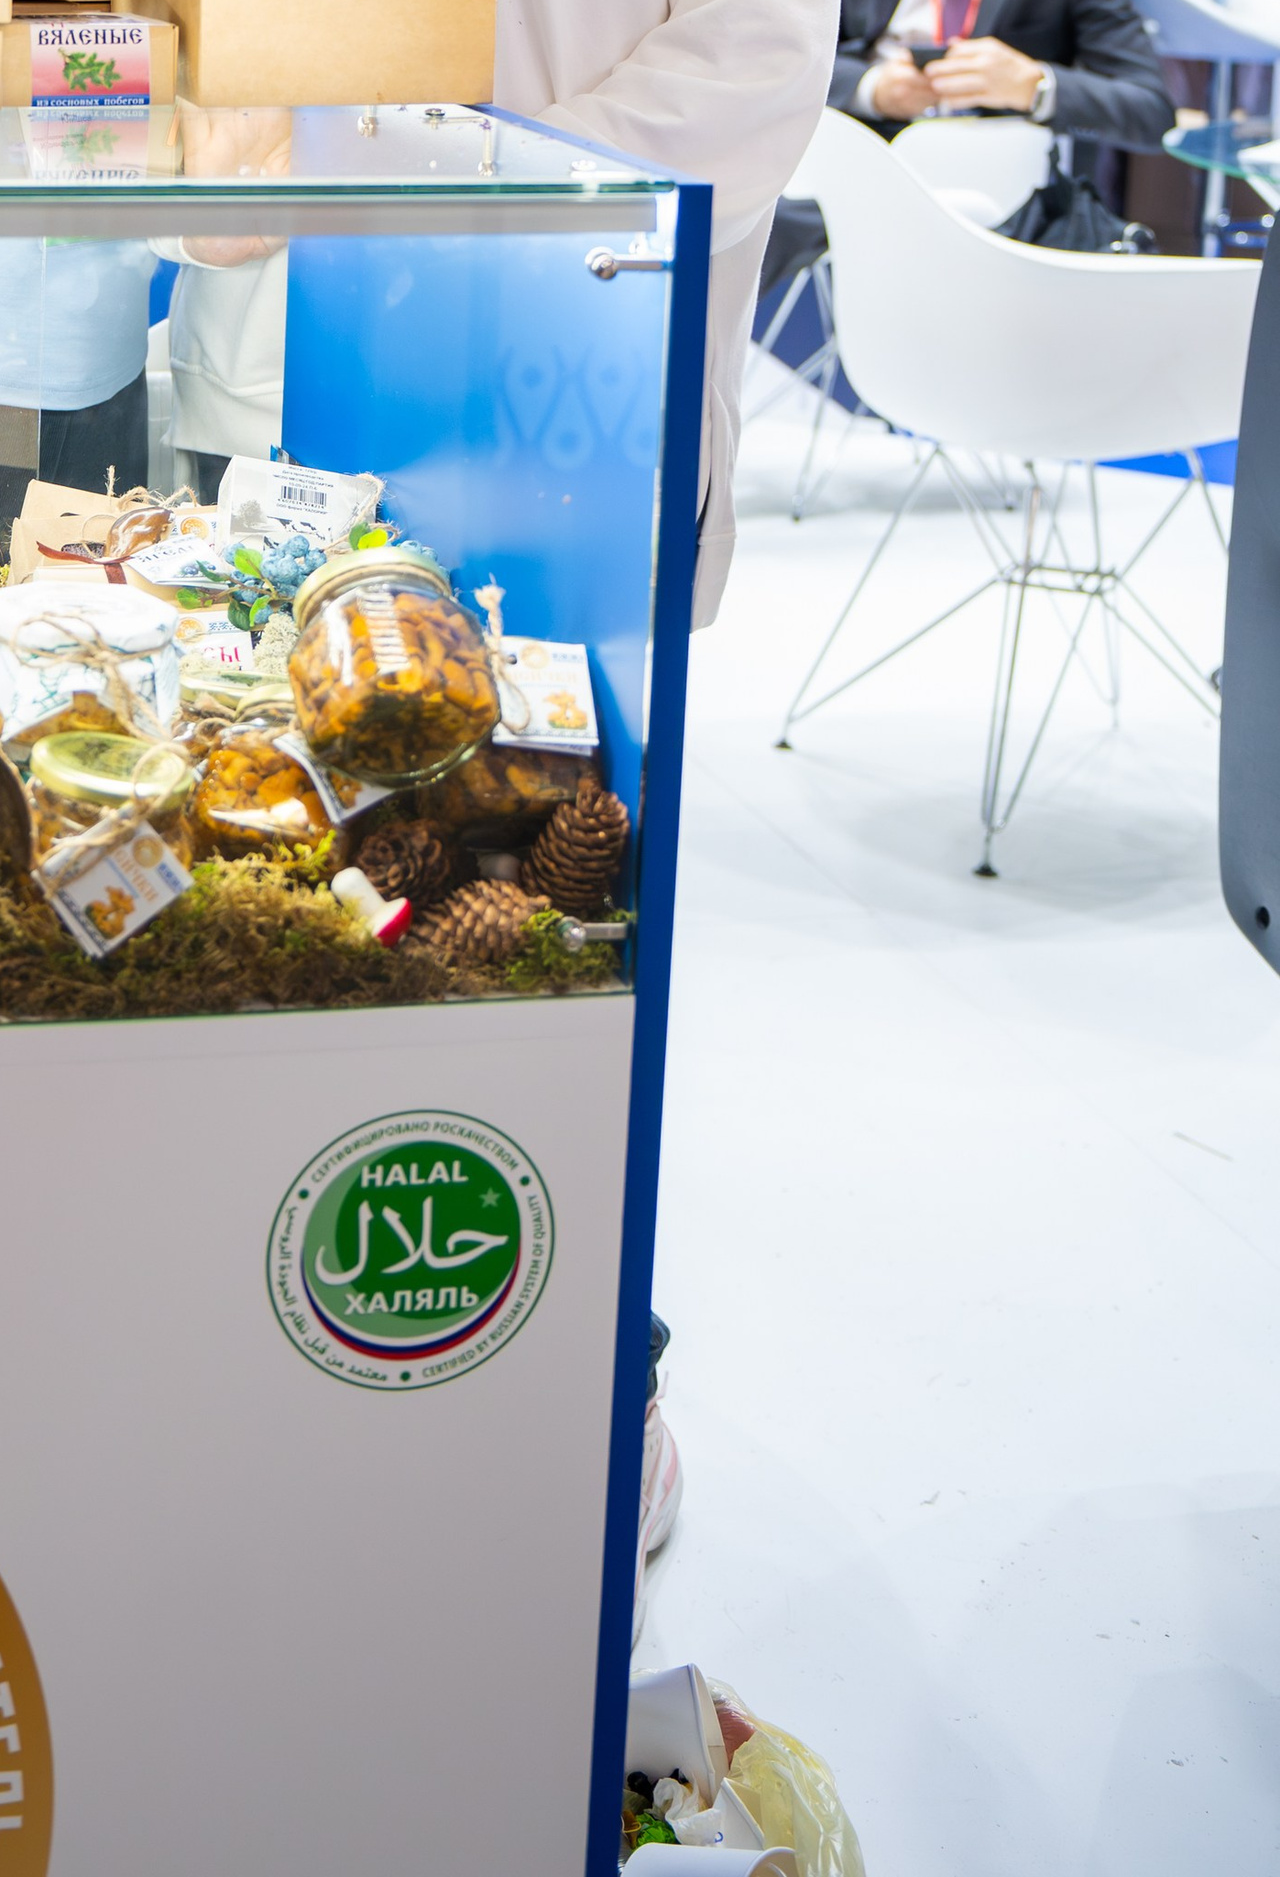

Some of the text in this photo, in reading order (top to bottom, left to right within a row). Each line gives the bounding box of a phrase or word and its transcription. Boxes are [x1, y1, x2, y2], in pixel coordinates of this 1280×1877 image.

[50, 97, 100, 107] сосновых
[104, 95, 145, 105] побегов
[432, 1120, 520, 1172] РОСКАЧЕСТВОМ
[361, 1160, 469, 1188] HALAL
[314, 1195, 509, 1286] حلال
[343, 1285, 480, 1315] ХАЛЯЛЬ
[421, 1193, 547, 1379] CERTIFIED BY RUSSIAN SYSTEM OF QUALITY
